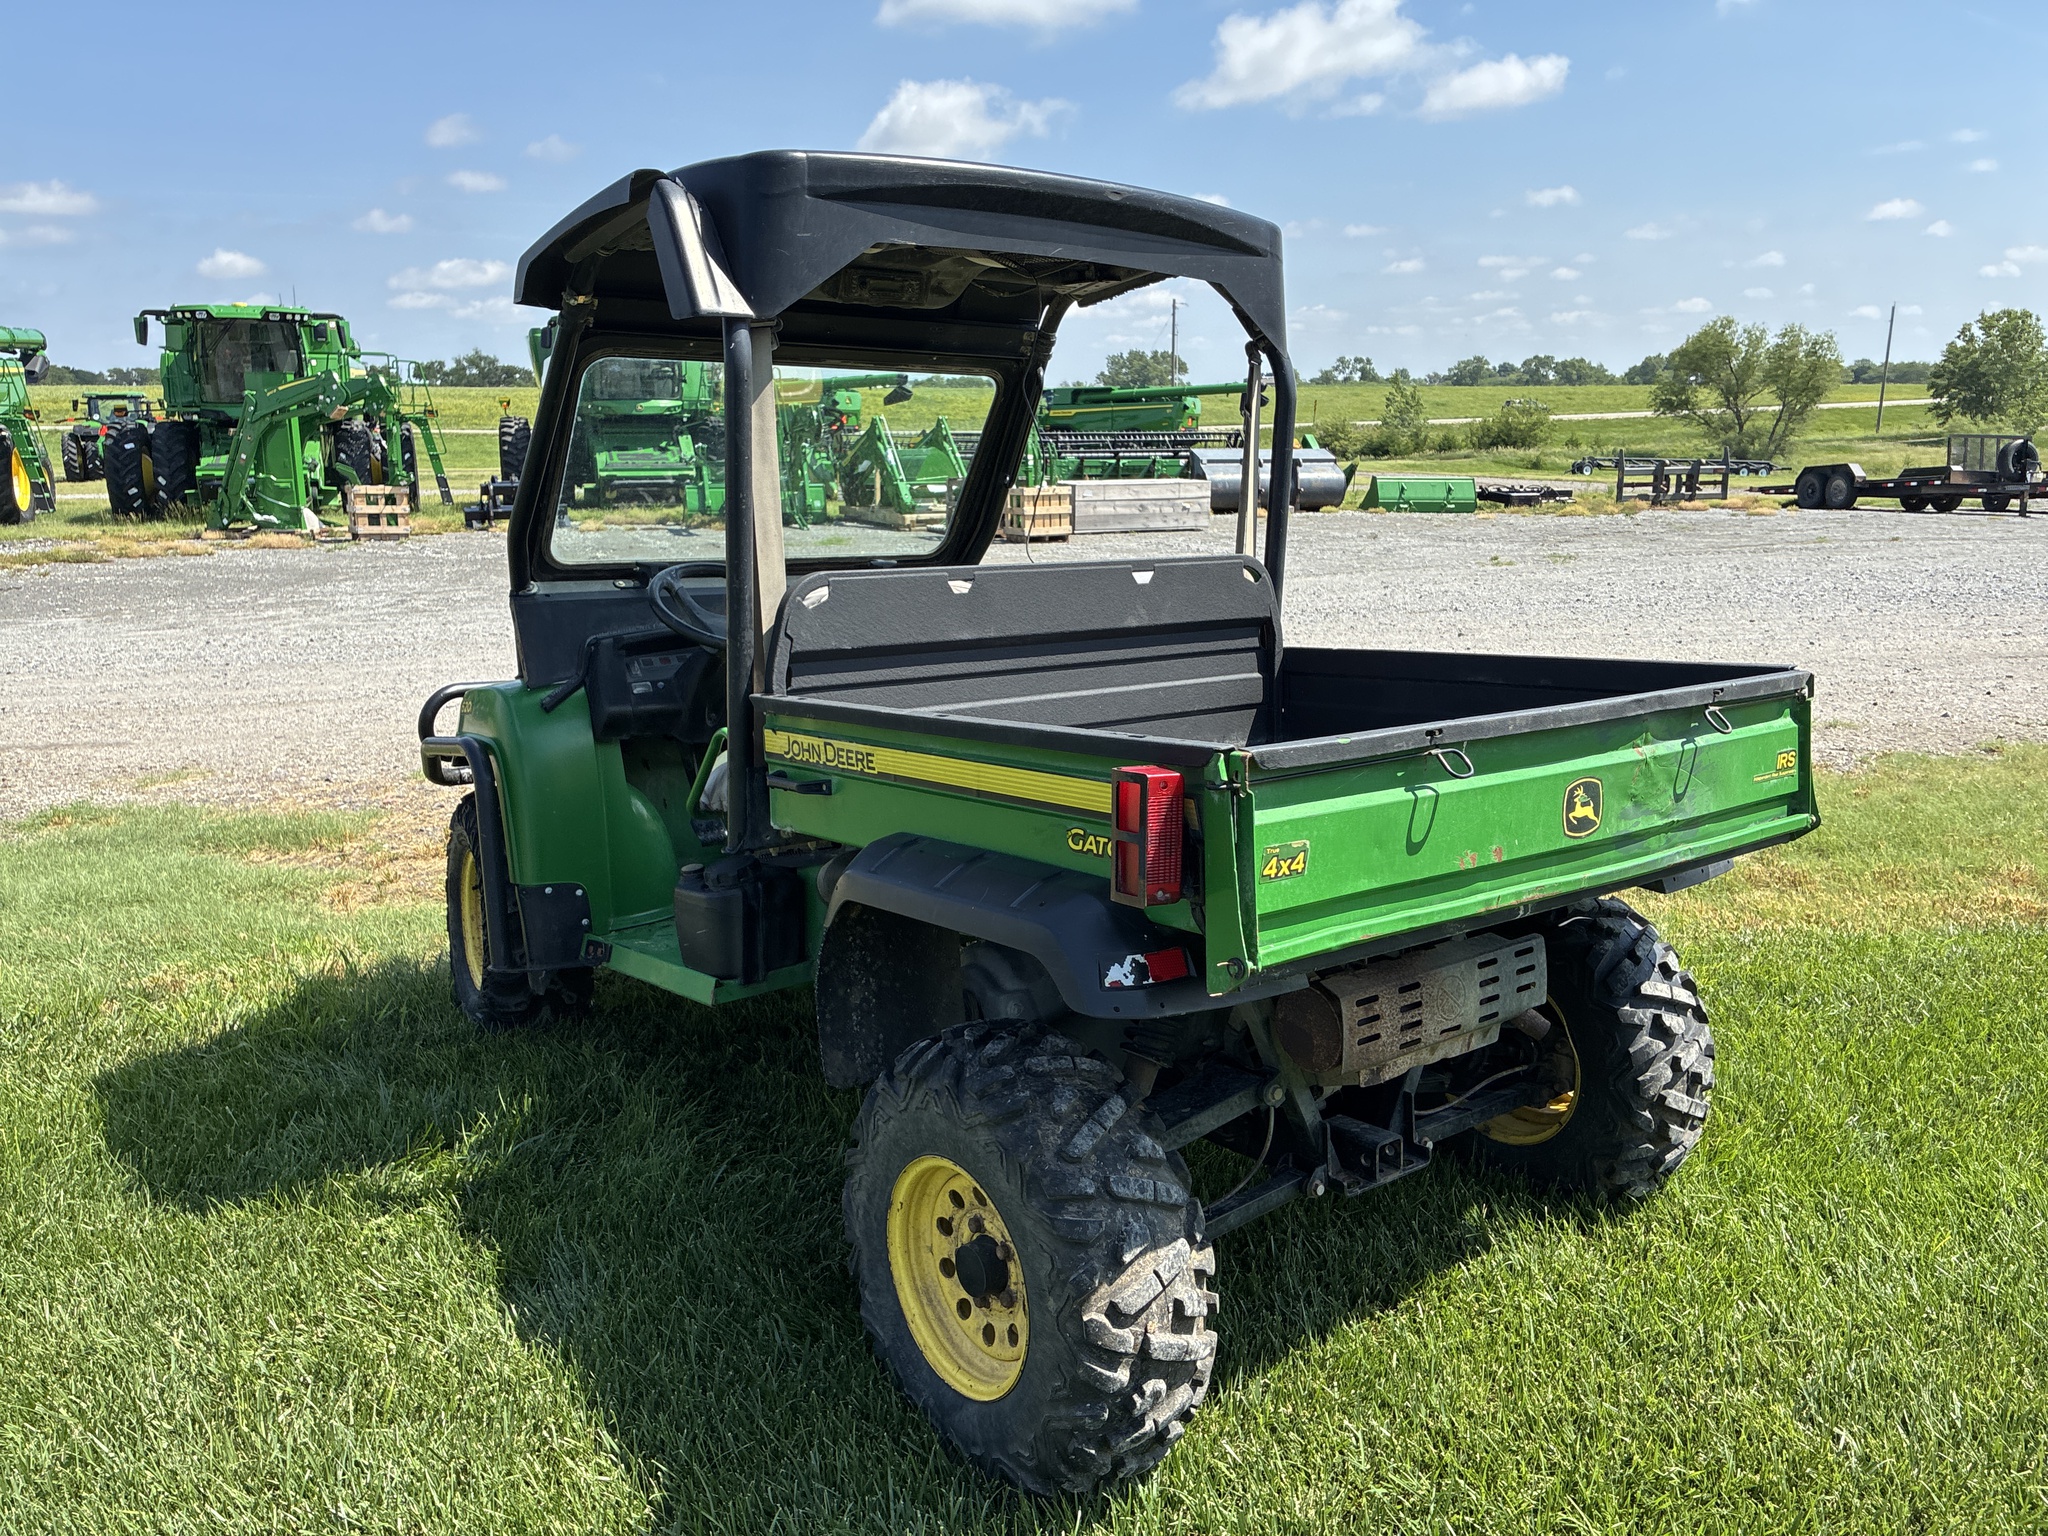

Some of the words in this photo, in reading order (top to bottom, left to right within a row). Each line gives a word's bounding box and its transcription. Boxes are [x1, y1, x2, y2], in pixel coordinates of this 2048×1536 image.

[783, 735, 822, 762] JOHN
[823, 741, 876, 771] DEERE
[1776, 750, 1797, 770] IRS
[1266, 847, 1280, 855] True
[1262, 851, 1305, 878] 4x4
